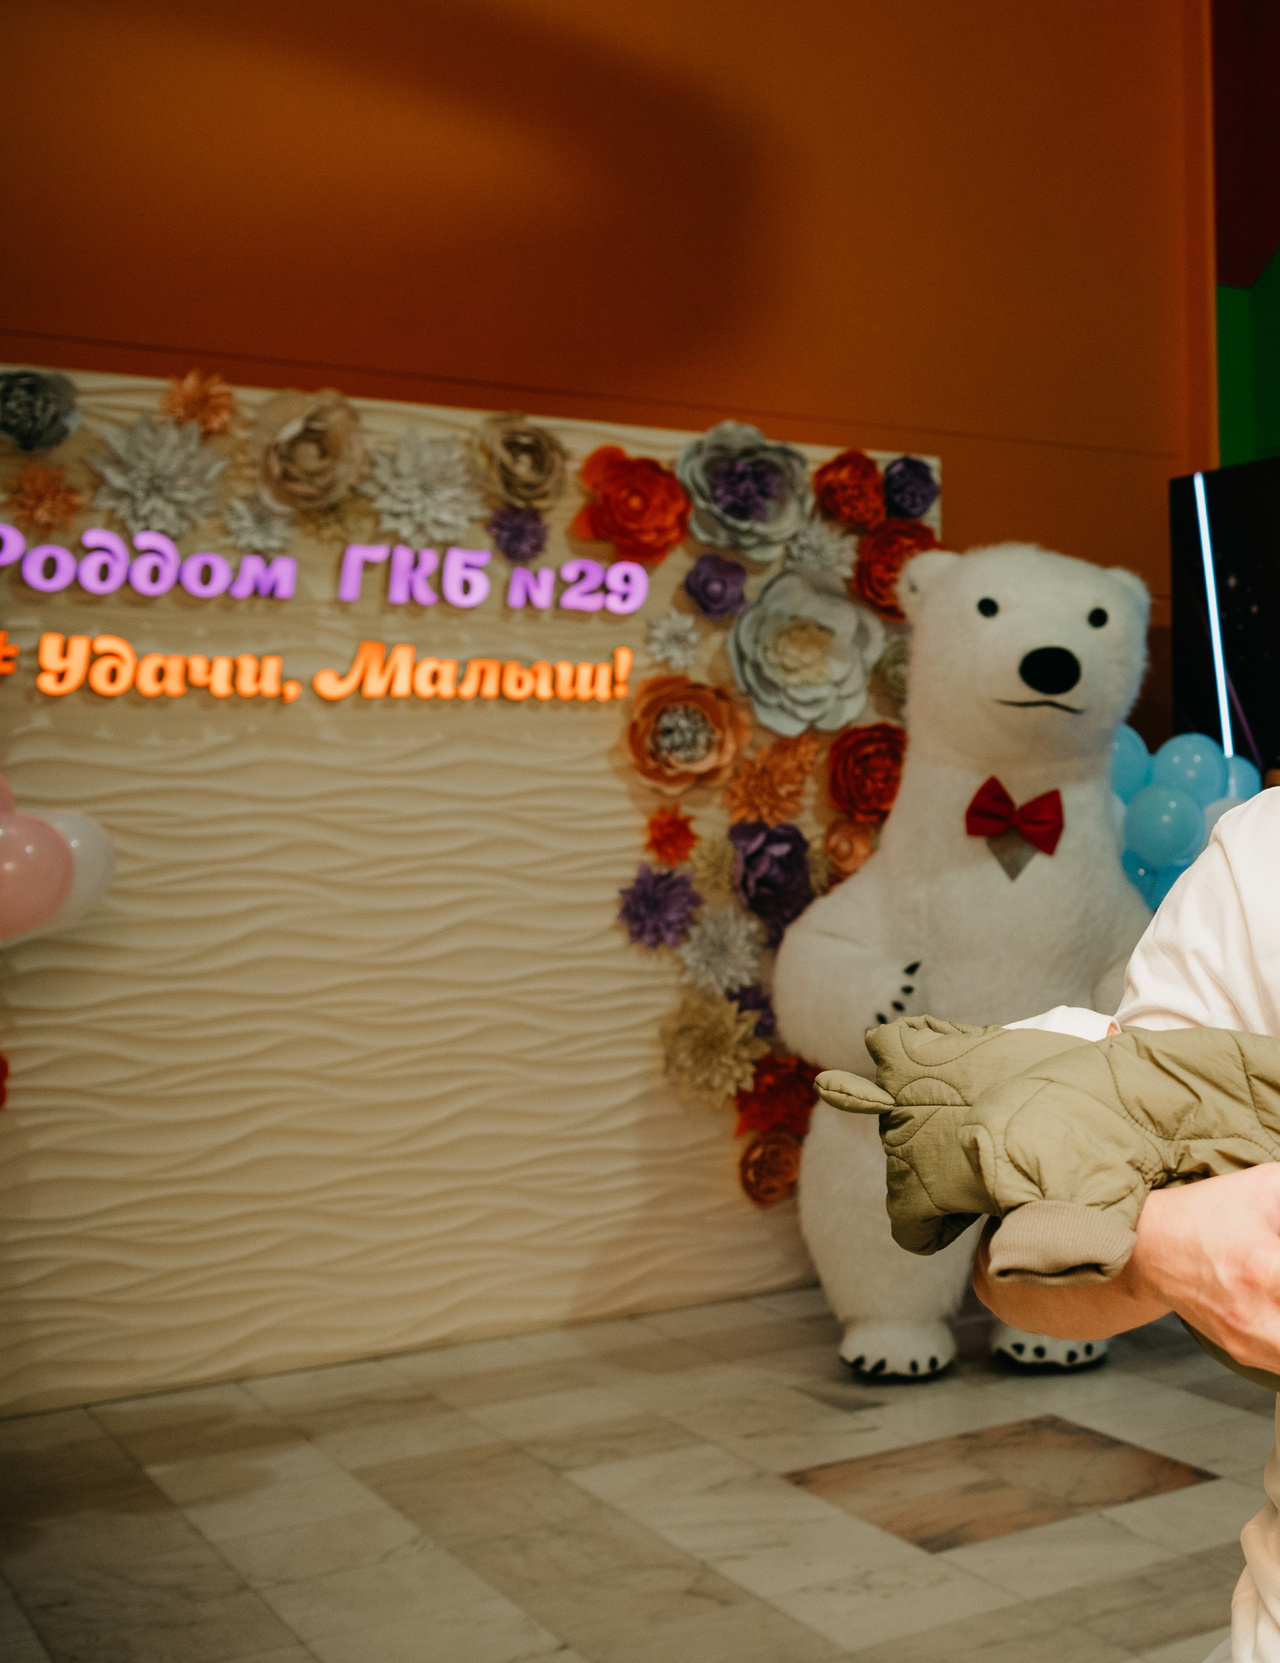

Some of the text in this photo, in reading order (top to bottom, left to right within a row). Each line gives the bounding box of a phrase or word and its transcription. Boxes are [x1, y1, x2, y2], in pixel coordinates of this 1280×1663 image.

[338, 545, 493, 608] ГКБ
[36, 632, 302, 703] Удачи,
[313, 640, 634, 701] Малыш!
